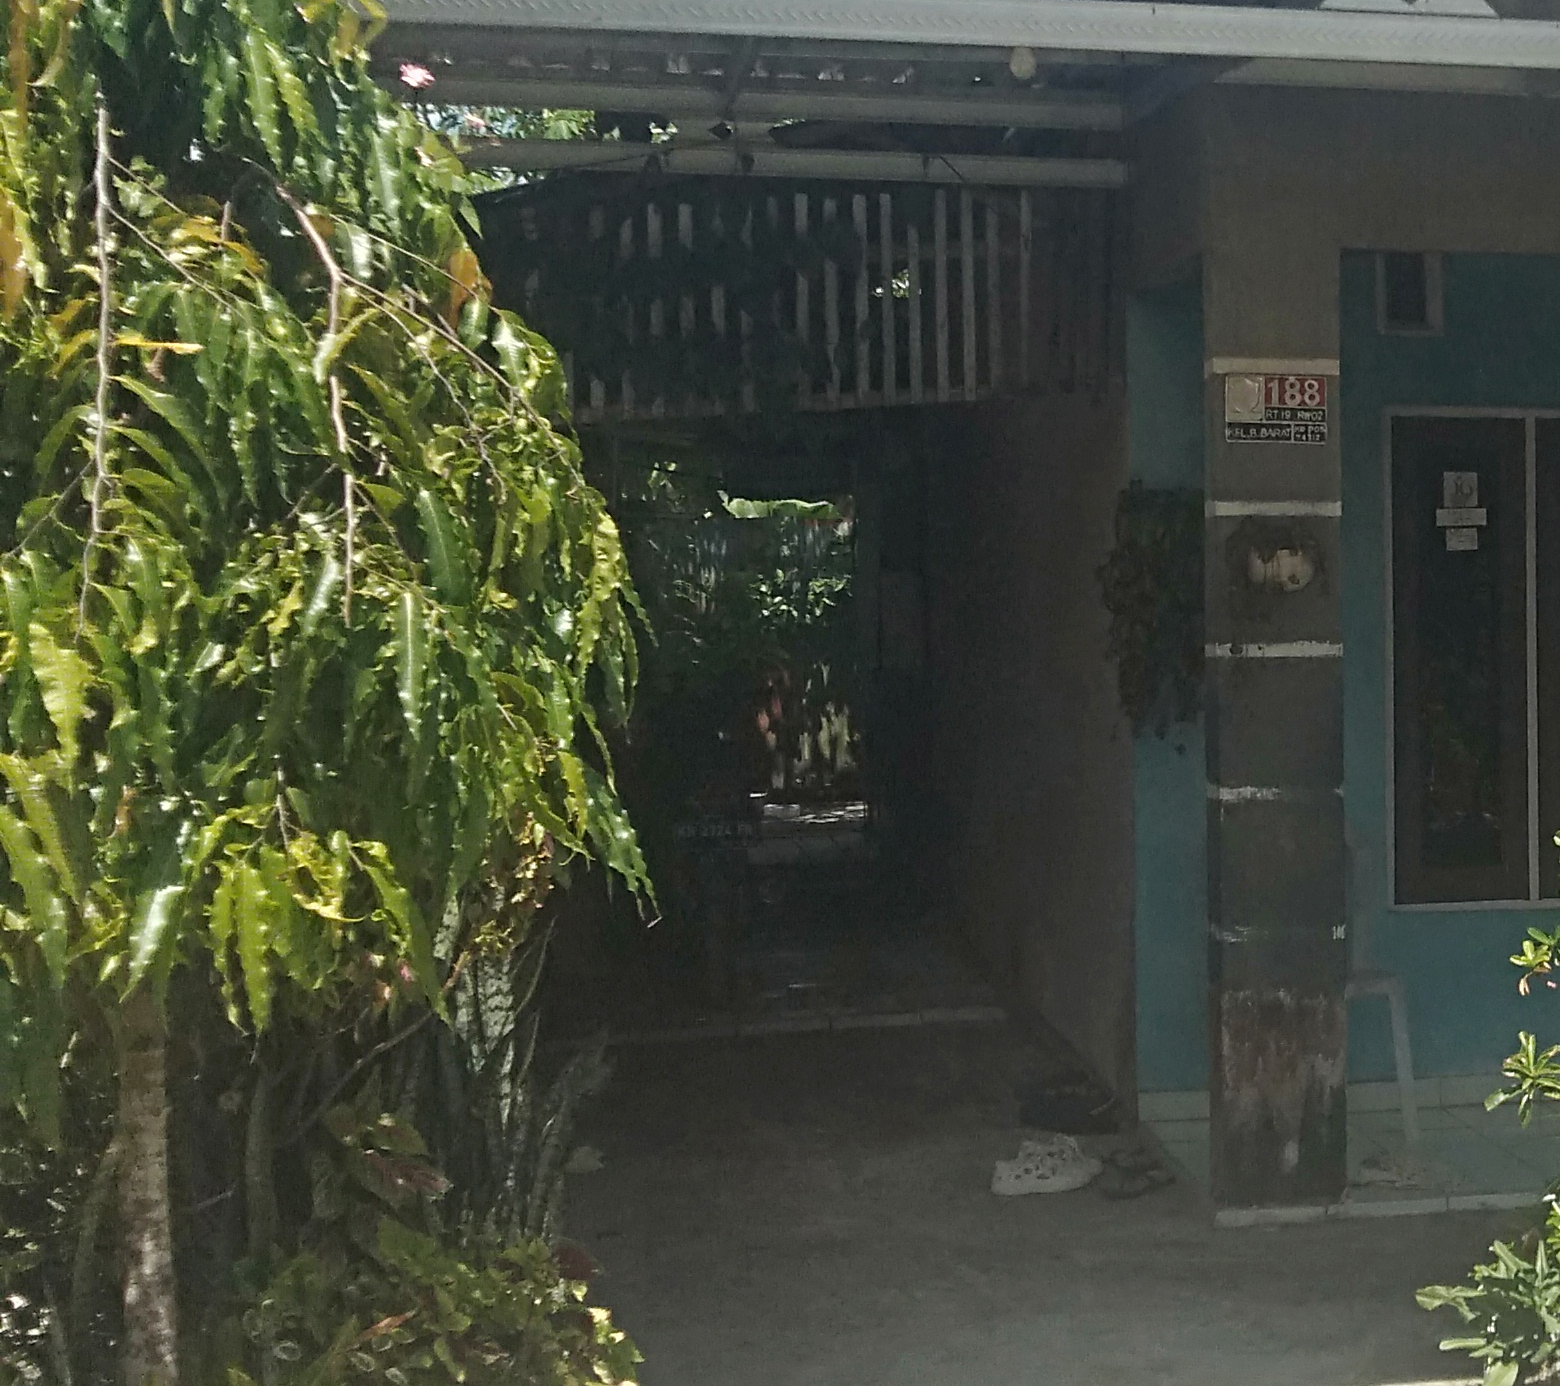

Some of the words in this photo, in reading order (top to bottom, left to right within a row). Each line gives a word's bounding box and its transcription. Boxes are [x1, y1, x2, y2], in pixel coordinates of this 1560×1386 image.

[1267, 377, 1321, 406] 188
[1266, 409, 1279, 419] RT
[1281, 410, 1291, 420] 19
